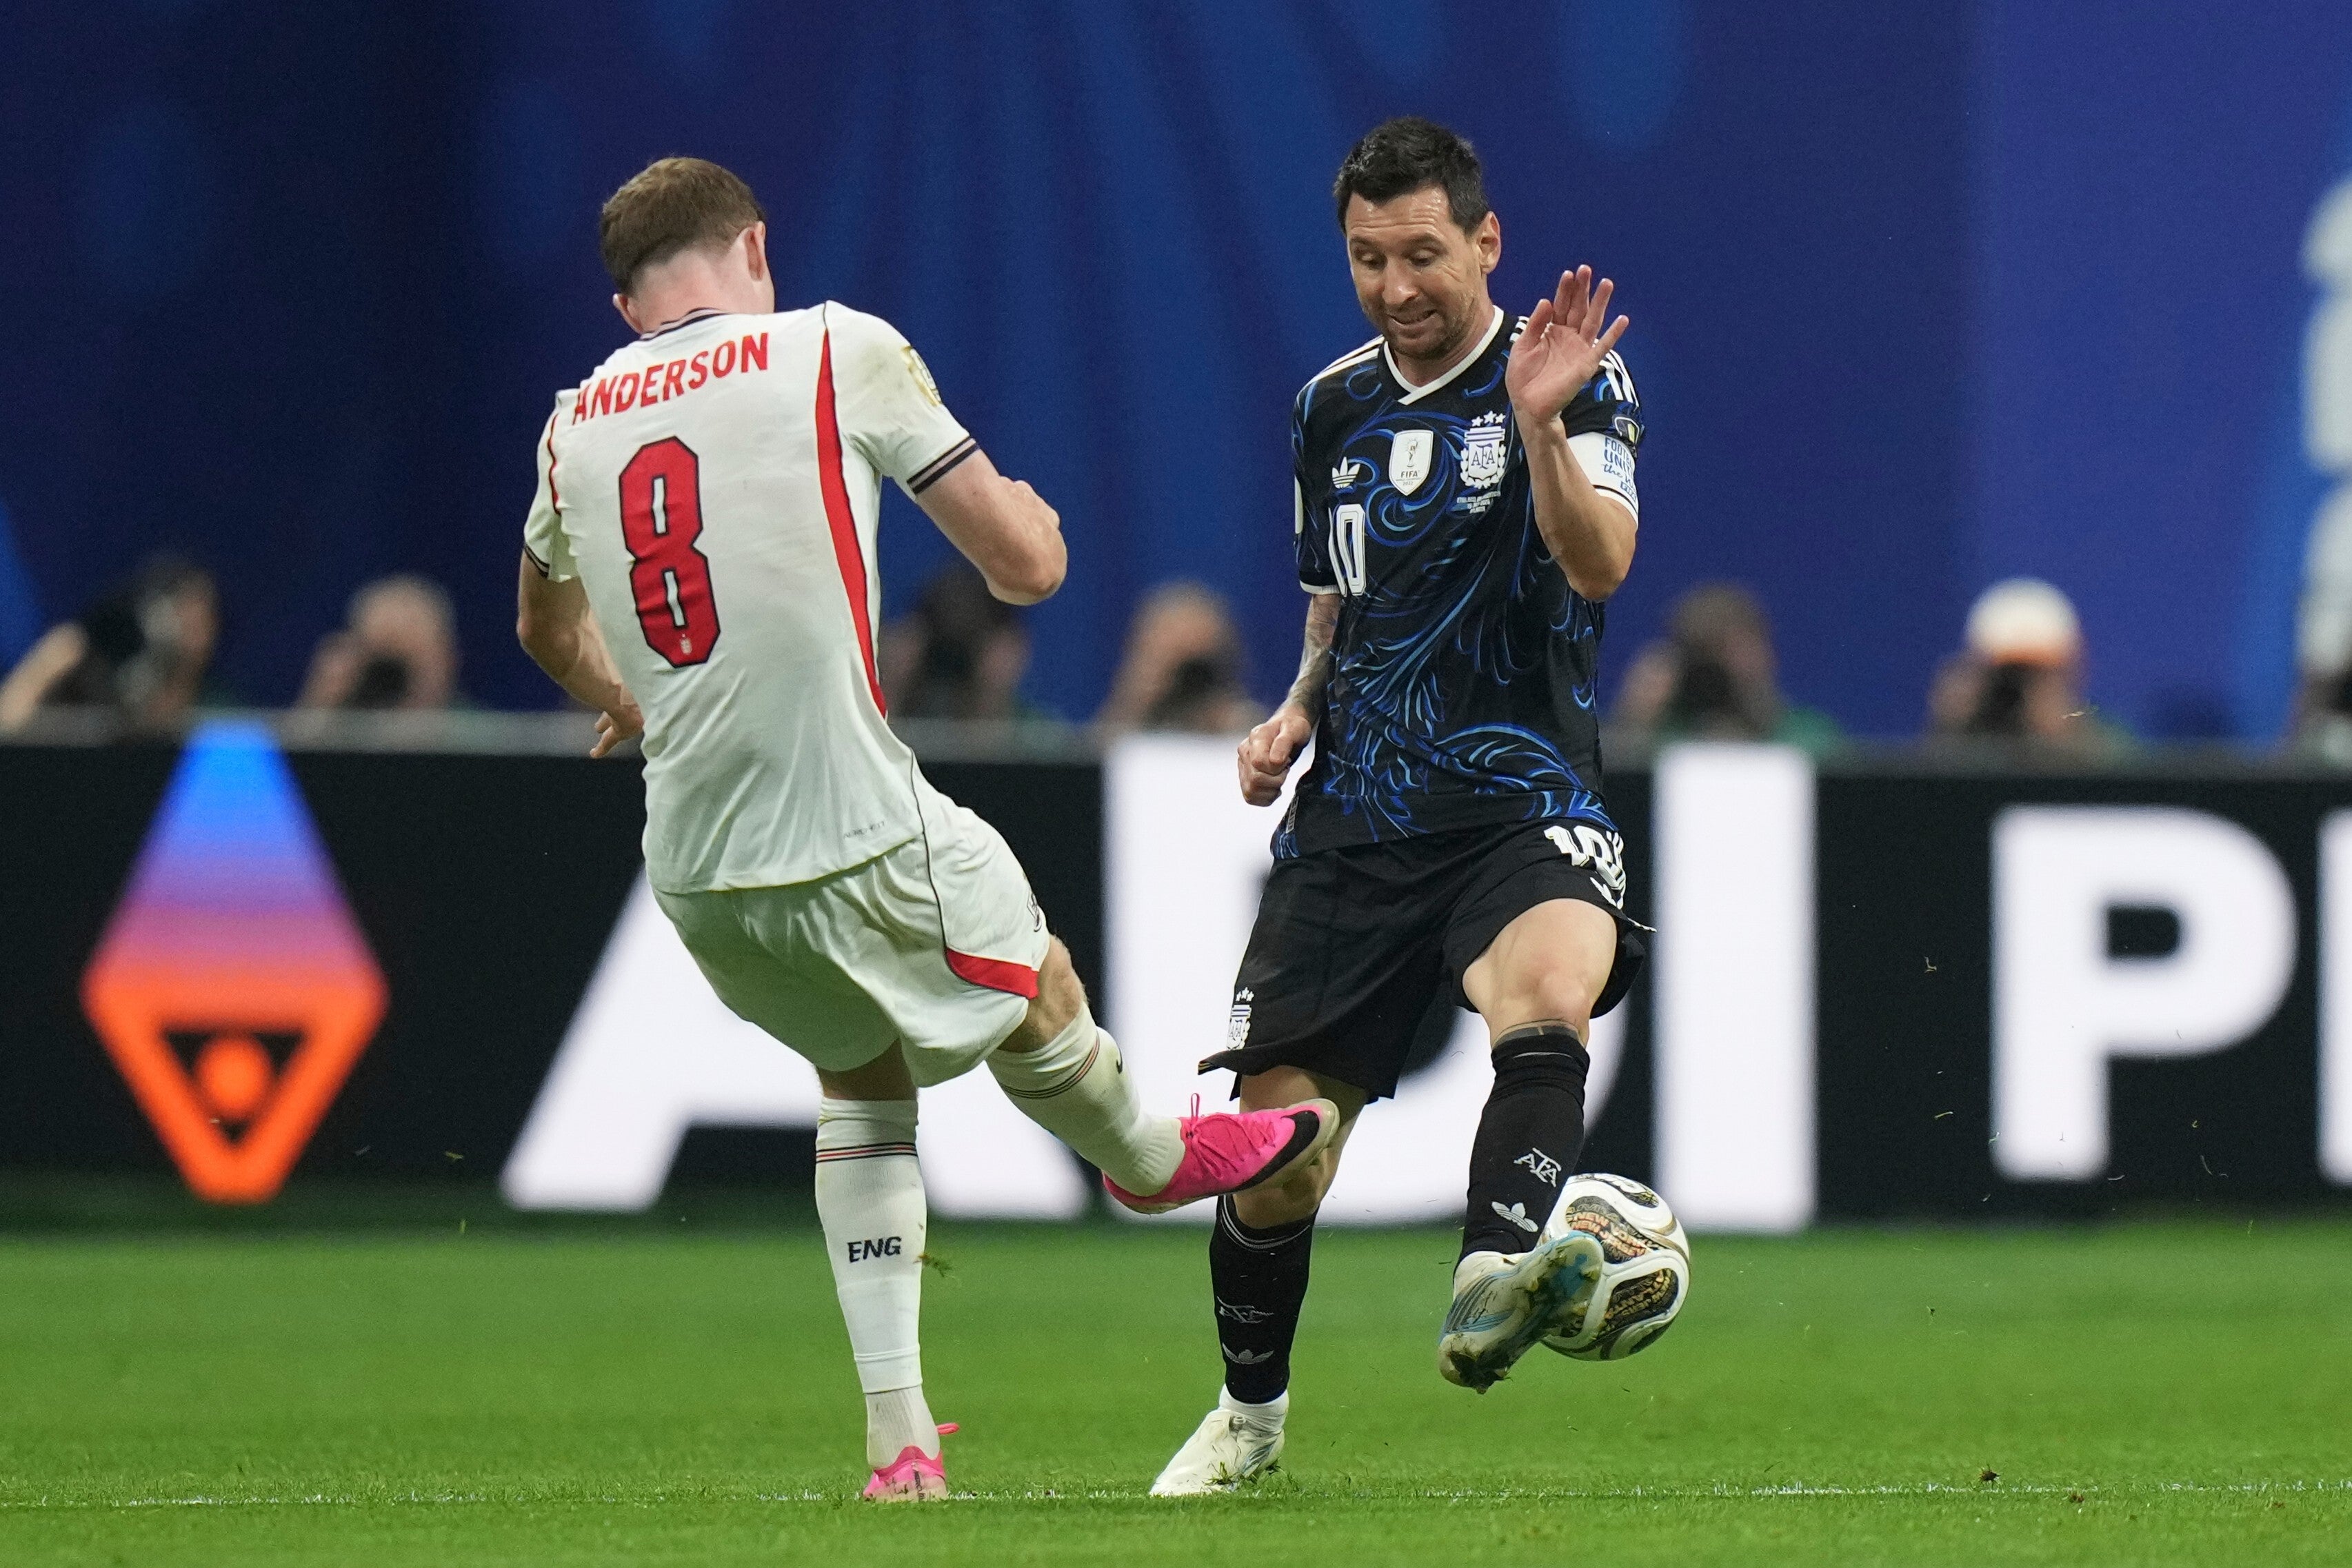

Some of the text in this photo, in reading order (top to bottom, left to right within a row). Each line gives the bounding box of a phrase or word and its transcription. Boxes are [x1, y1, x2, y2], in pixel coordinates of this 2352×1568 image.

[572, 332, 769, 425] ANDERSON
[1400, 470, 1418, 479] FIFA
[1471, 443, 1495, 470] AFA
[619, 436, 721, 667] 8
[1328, 503, 1366, 597] 10
[1513, 1147, 1562, 1187] AFA
[847, 1236, 902, 1263] ENG
